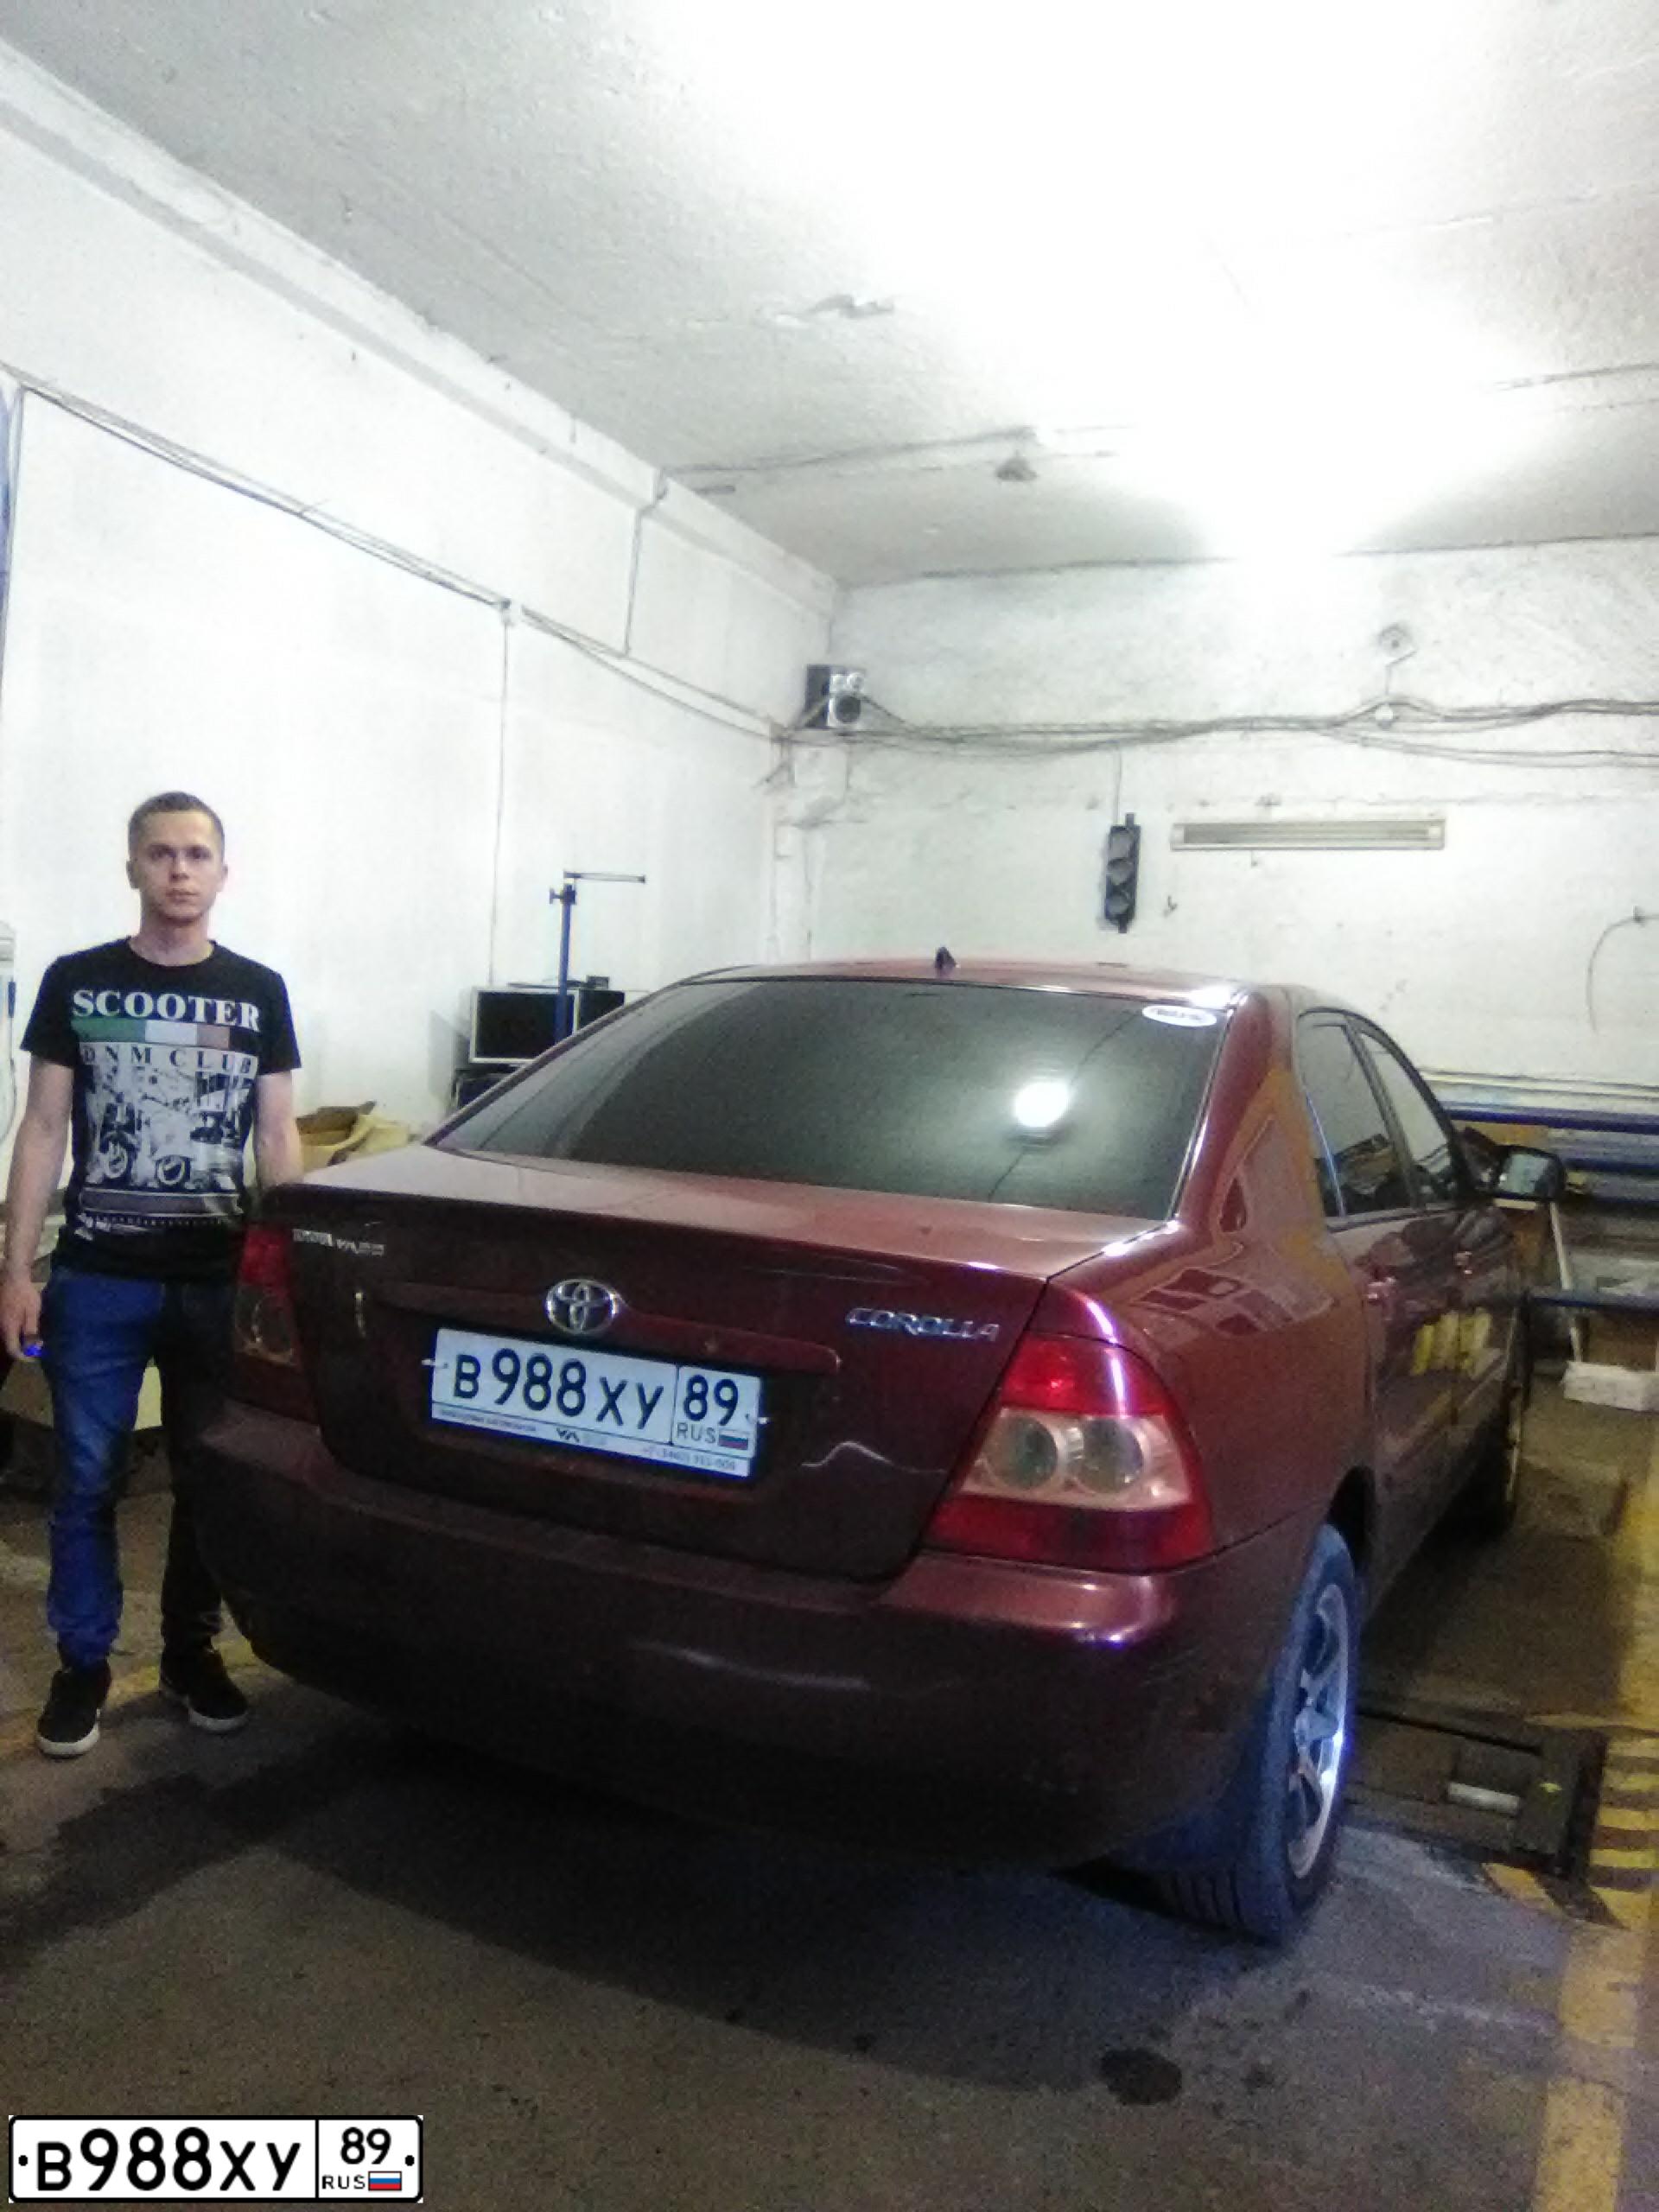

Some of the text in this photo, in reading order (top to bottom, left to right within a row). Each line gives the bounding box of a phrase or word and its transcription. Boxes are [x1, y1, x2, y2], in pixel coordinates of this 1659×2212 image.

[73, 989, 260, 1033] SCOOTER
[845, 1307, 1000, 1341] COROLLA
[683, 1374, 739, 1427] 89
[676, 1421, 716, 1445] RUS
